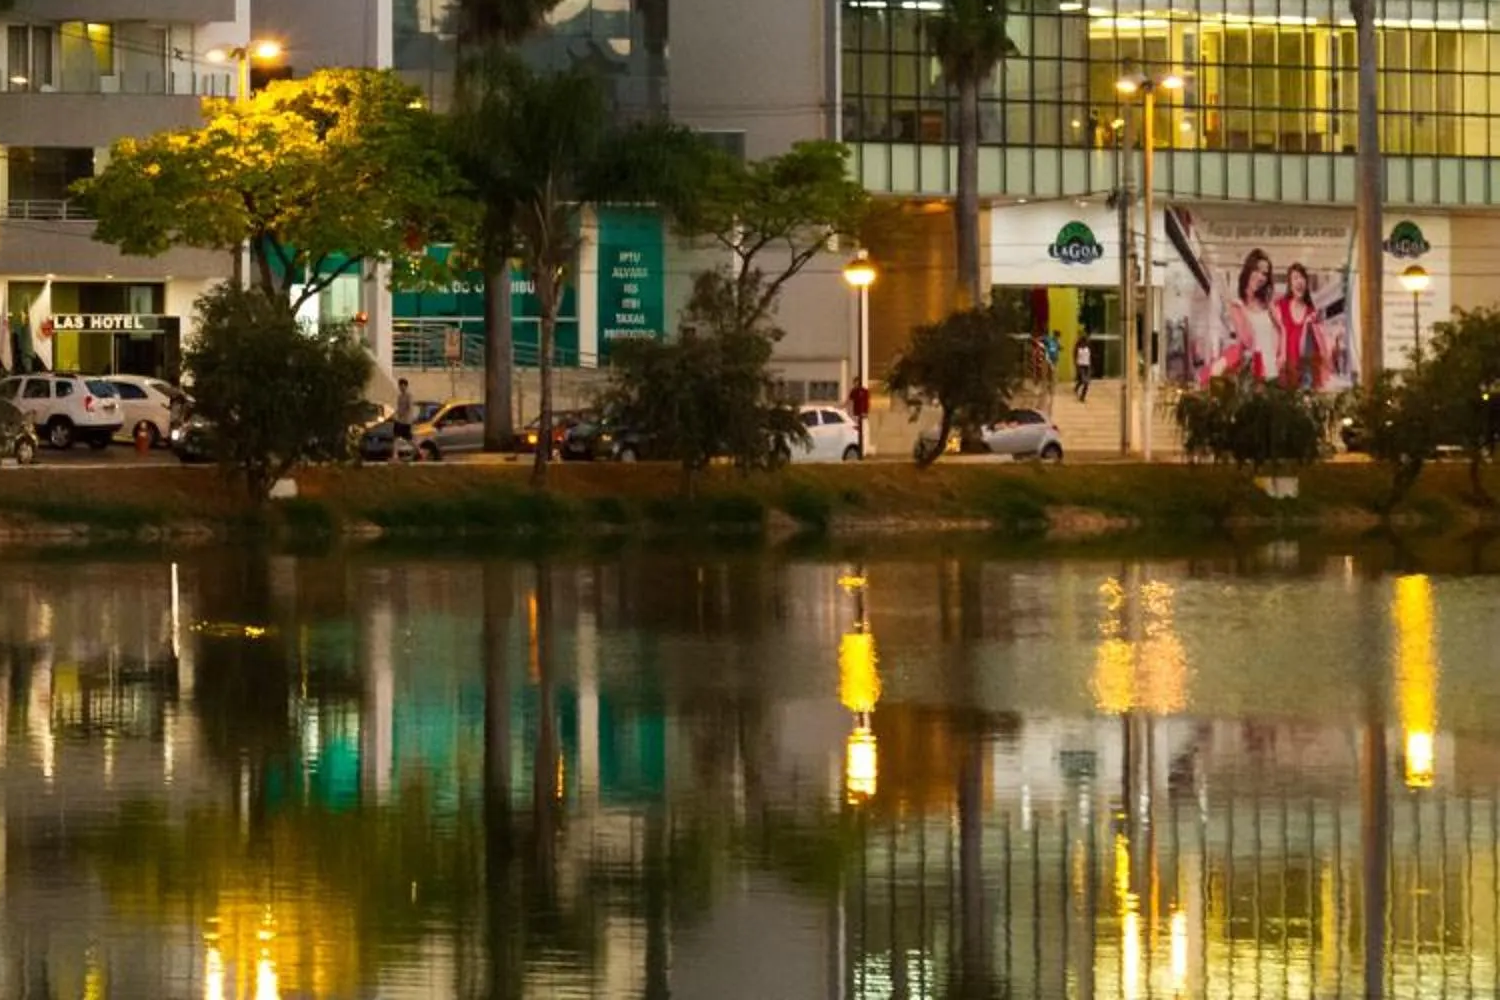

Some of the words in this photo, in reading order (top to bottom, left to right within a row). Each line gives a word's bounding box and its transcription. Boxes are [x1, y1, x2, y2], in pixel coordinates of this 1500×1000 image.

[1269, 223, 1300, 237] deste
[1053, 242, 1099, 260] LAGOA
[53, 315, 84, 329] LAS
[91, 315, 144, 329] HOTEL
